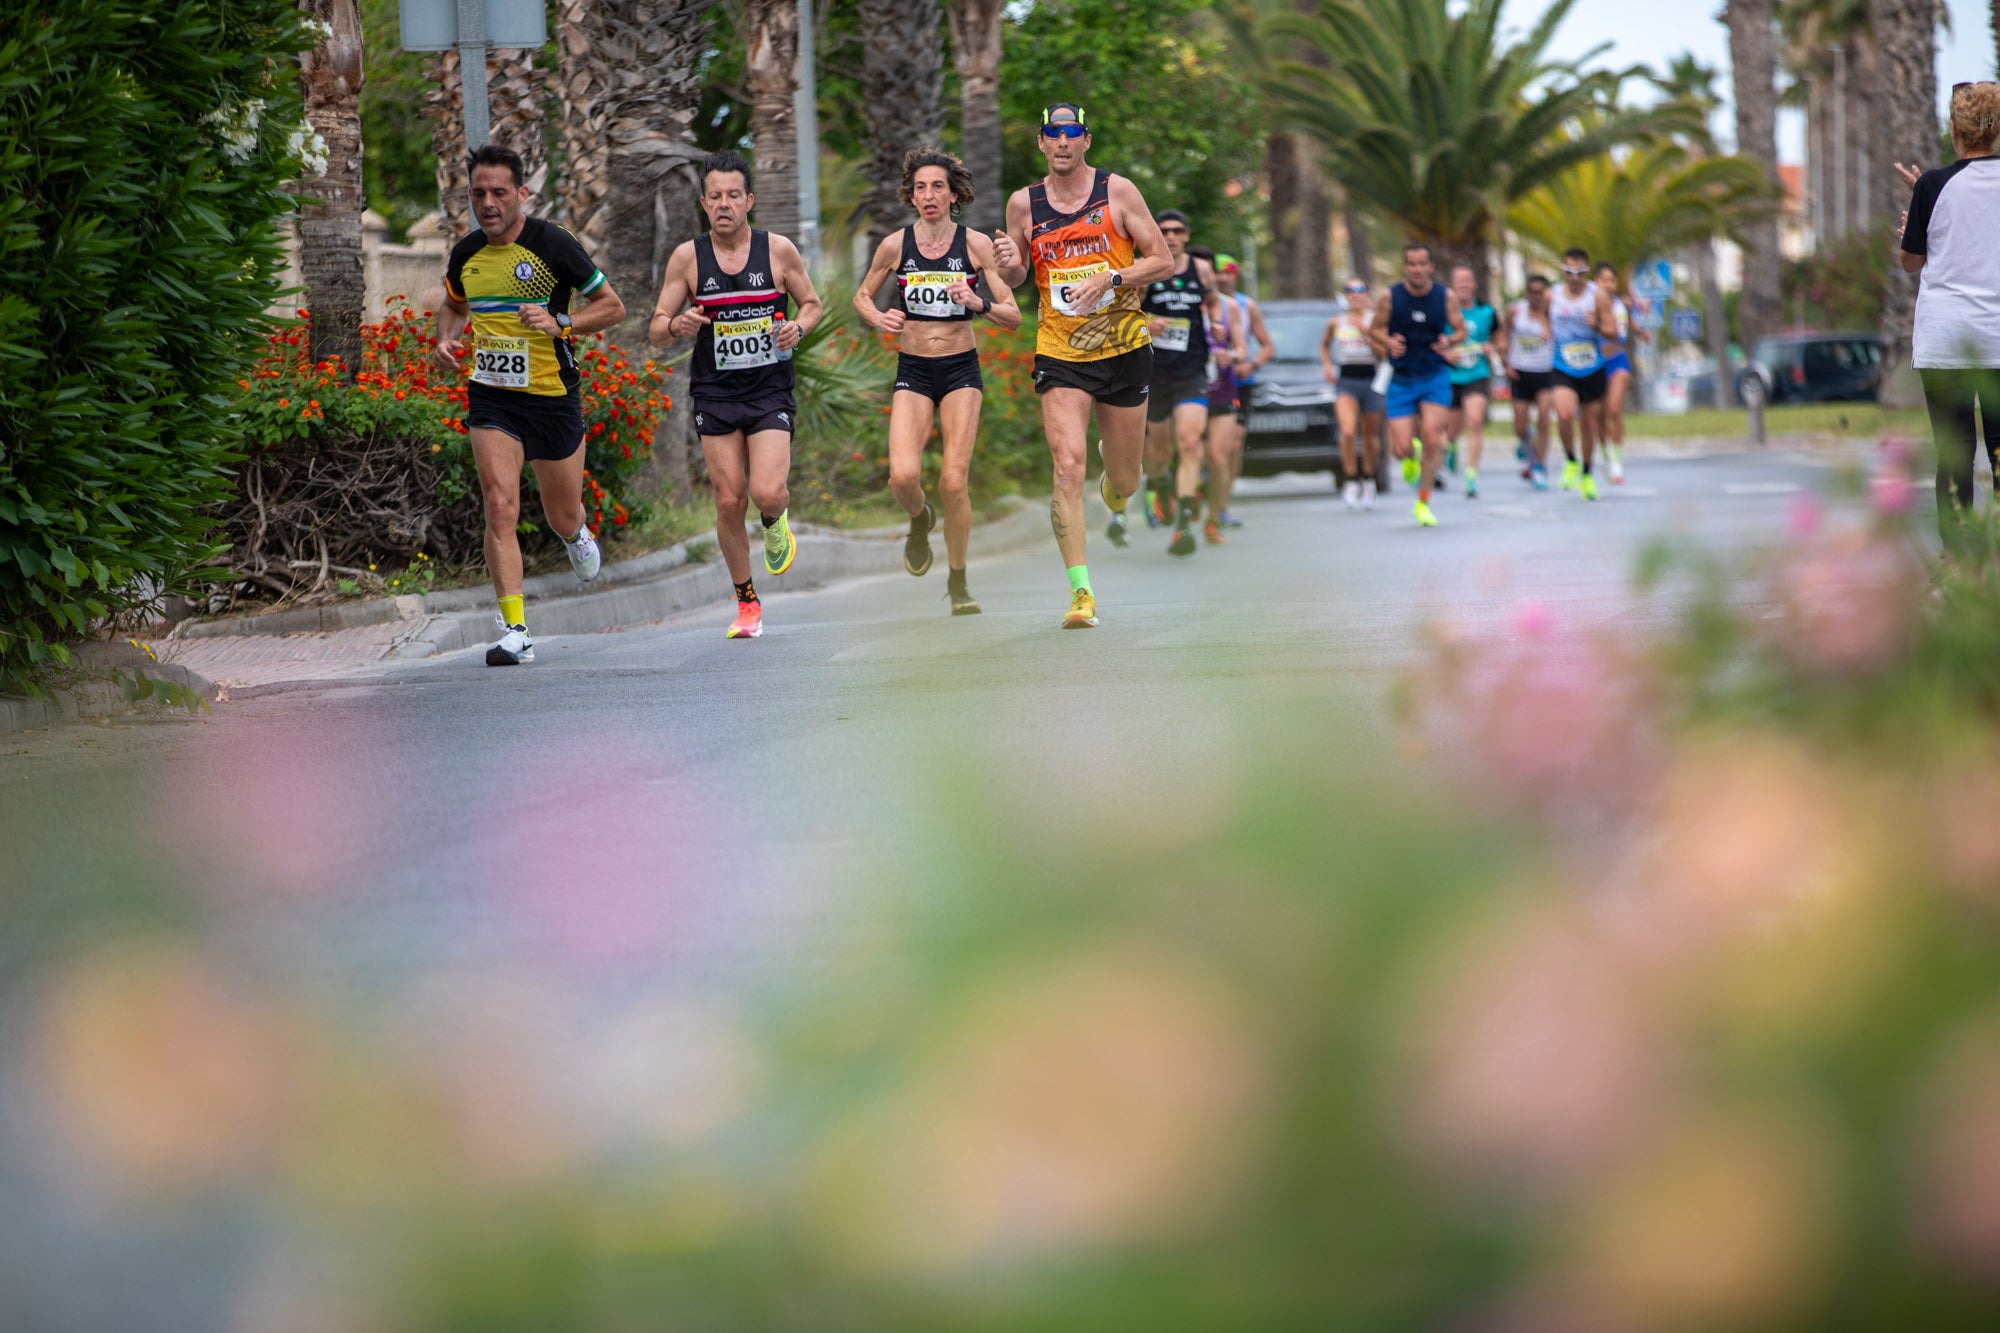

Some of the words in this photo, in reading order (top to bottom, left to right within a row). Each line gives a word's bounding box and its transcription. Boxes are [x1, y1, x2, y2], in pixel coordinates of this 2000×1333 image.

[1038, 242, 1057, 260] LA
[1064, 233, 1111, 258] ZUBIA
[1045, 241, 1061, 249] Club
[1063, 235, 1100, 247] Deportivo
[1057, 272, 1065, 281] 38
[907, 288, 957, 305] 404
[730, 324, 762, 334] FONDO
[488, 340, 515, 349] ONDO
[717, 334, 773, 356] 4003
[476, 352, 526, 374] 3228
